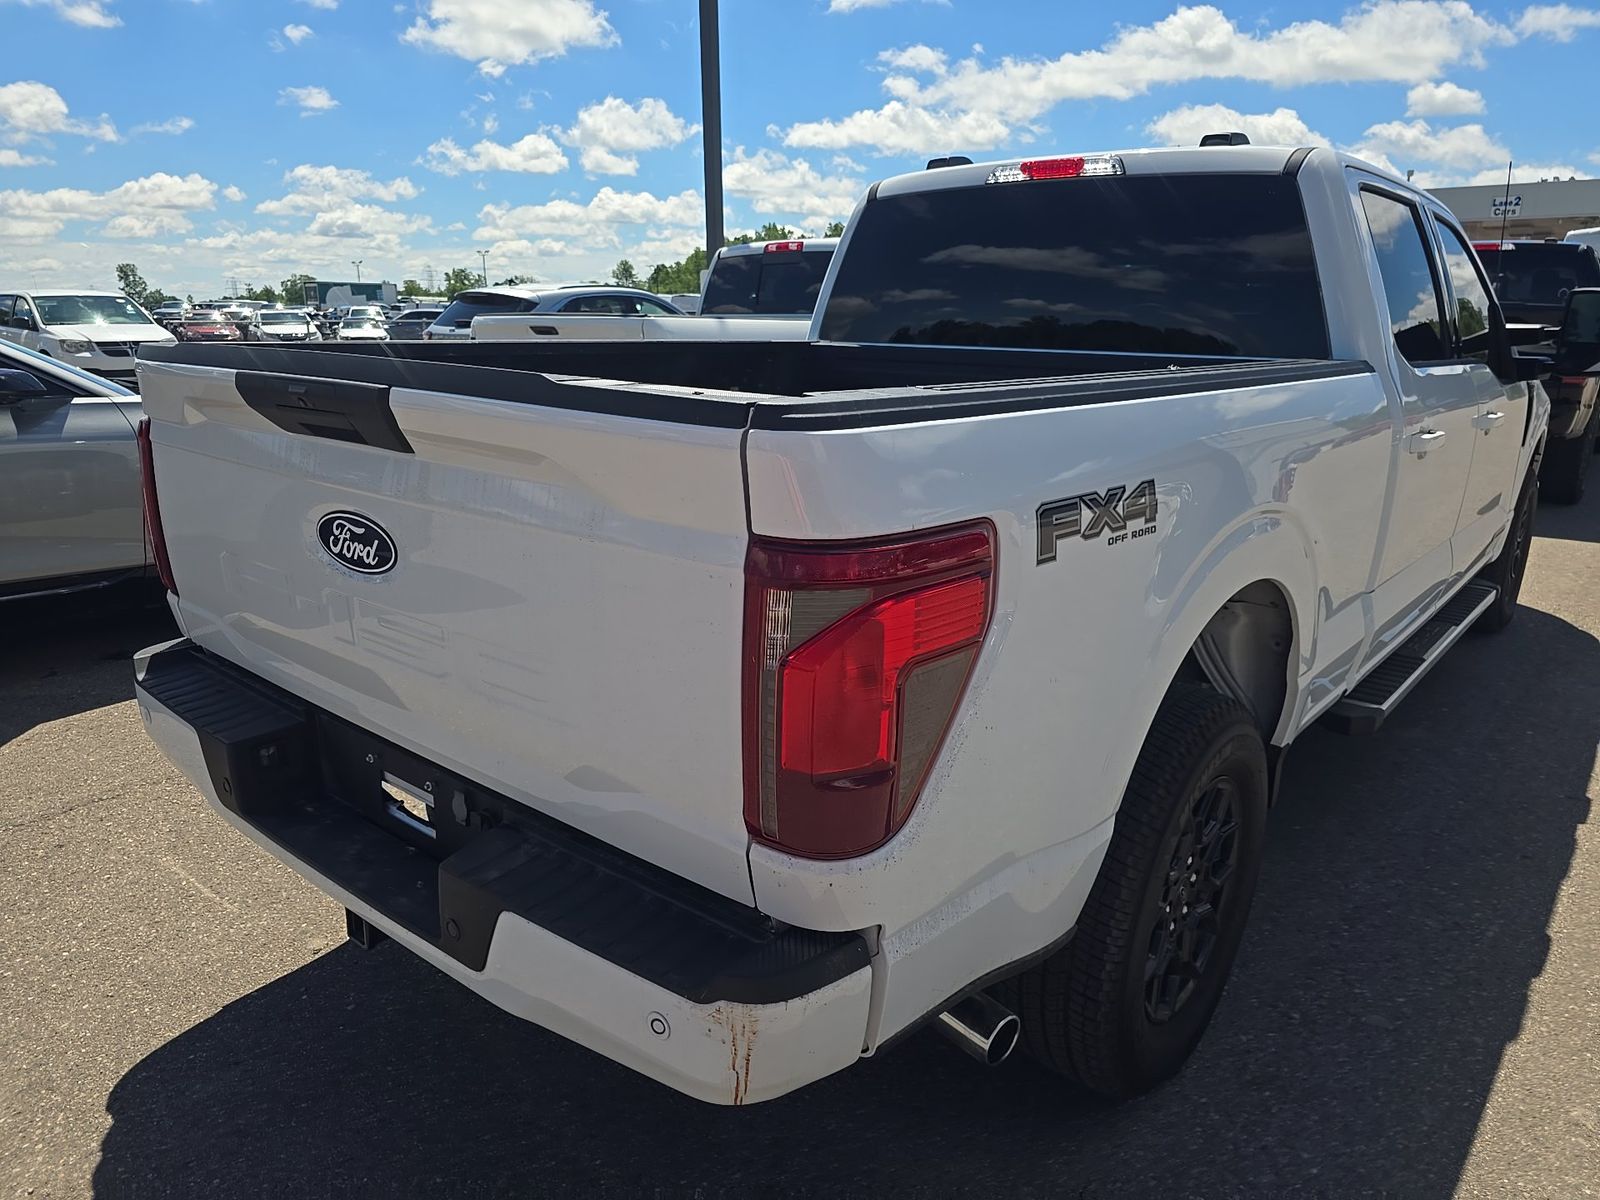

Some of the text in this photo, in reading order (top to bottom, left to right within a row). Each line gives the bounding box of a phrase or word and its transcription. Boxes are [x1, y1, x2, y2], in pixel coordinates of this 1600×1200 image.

[1514, 196, 1522, 206] 2
[1036, 478, 1158, 567] FX4
[1107, 525, 1157, 546] OFF ROAD
[330, 519, 378, 565] Ford
